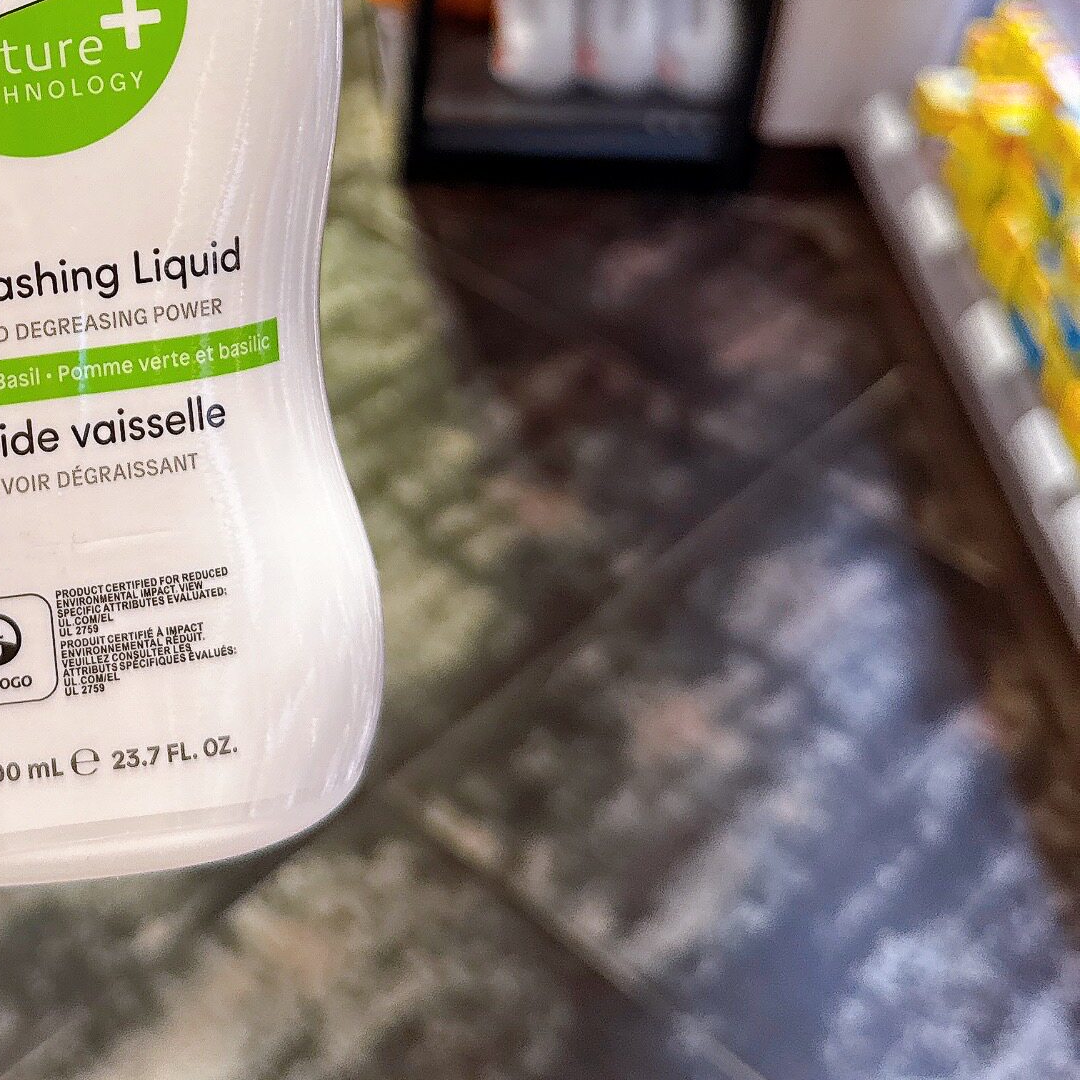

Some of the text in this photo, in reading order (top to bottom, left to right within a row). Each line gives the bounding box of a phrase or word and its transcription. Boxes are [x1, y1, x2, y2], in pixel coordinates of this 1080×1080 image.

[133, 234, 242, 280] Liquid
[15, 308, 148, 341] DEGREASING
[153, 297, 223, 324] POWER
[57, 358, 135, 383] Pomme
[139, 345, 191, 372] verte
[194, 344, 216, 364] et
[219, 330, 271, 361] basilic
[71, 395, 227, 449] vaisselle
[56, 452, 200, 490] DÉGRAISSANT
[55, 566, 229, 599] PRODUCT CERTIFIED FOR REDUCED
[56, 589, 139, 609] ENVIRONMENTAL
[178, 580, 204, 593] VIEW
[57, 604, 101, 619] SPECIFIC
[103, 595, 165, 613] ATTRIBUTES
[59, 624, 99, 637] UL 2759
[60, 635, 106, 650] PRODUIT
[107, 626, 154, 643] CERTIFIÉ
[165, 621, 204, 636] IMPACT
[61, 637, 164, 659] ENVIRONNEMENTAL
[62, 643, 192, 668] VEUILLEZ CONSULTER LES
[63, 662, 118, 677] ATTRIBUTS
[64, 683, 105, 697] UL 2759
[27, 757, 64, 780] mL
[111, 744, 160, 771] 23.7
[166, 741, 198, 763] FL.
[203, 735, 238, 758] OZ.
